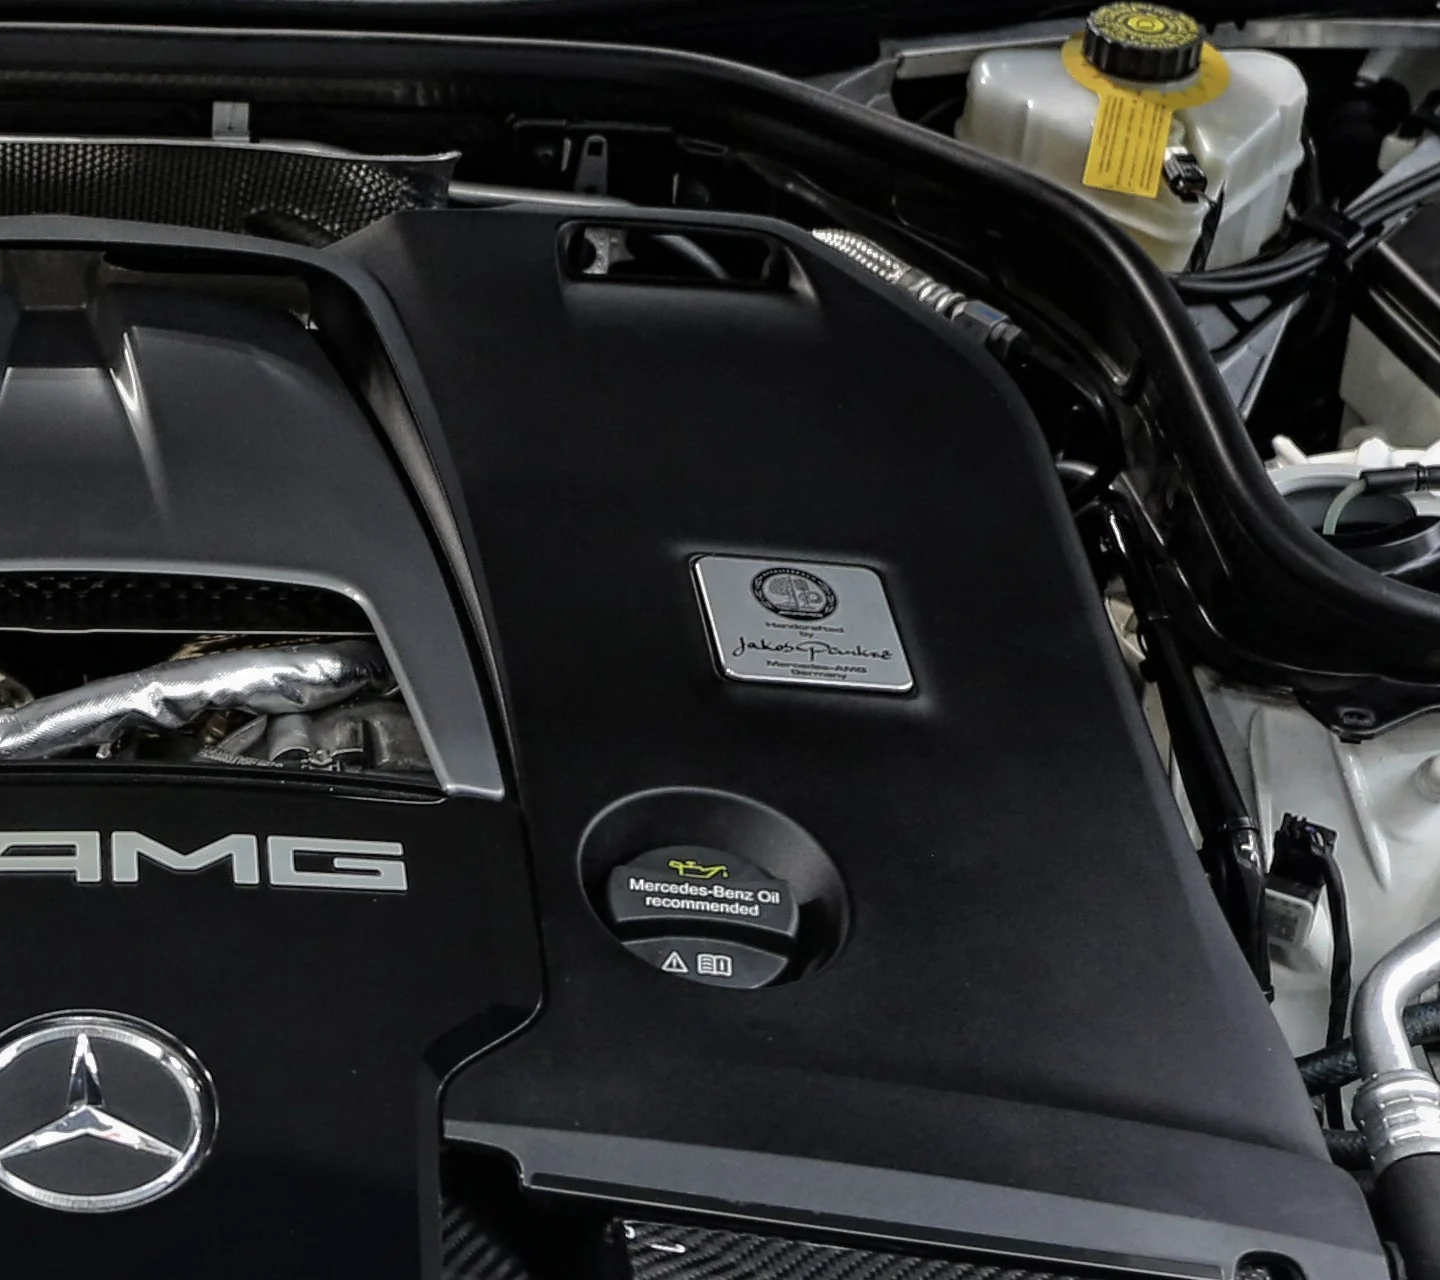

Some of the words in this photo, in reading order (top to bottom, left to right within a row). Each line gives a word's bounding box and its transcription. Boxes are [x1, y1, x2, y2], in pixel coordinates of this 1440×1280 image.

[765, 660, 868, 674] Mercedes-AMG
[790, 669, 848, 680] Germany
[629, 878, 755, 901] Mercedes-Benz
[757, 890, 780, 904] Oil
[645, 896, 760, 916] recommended
